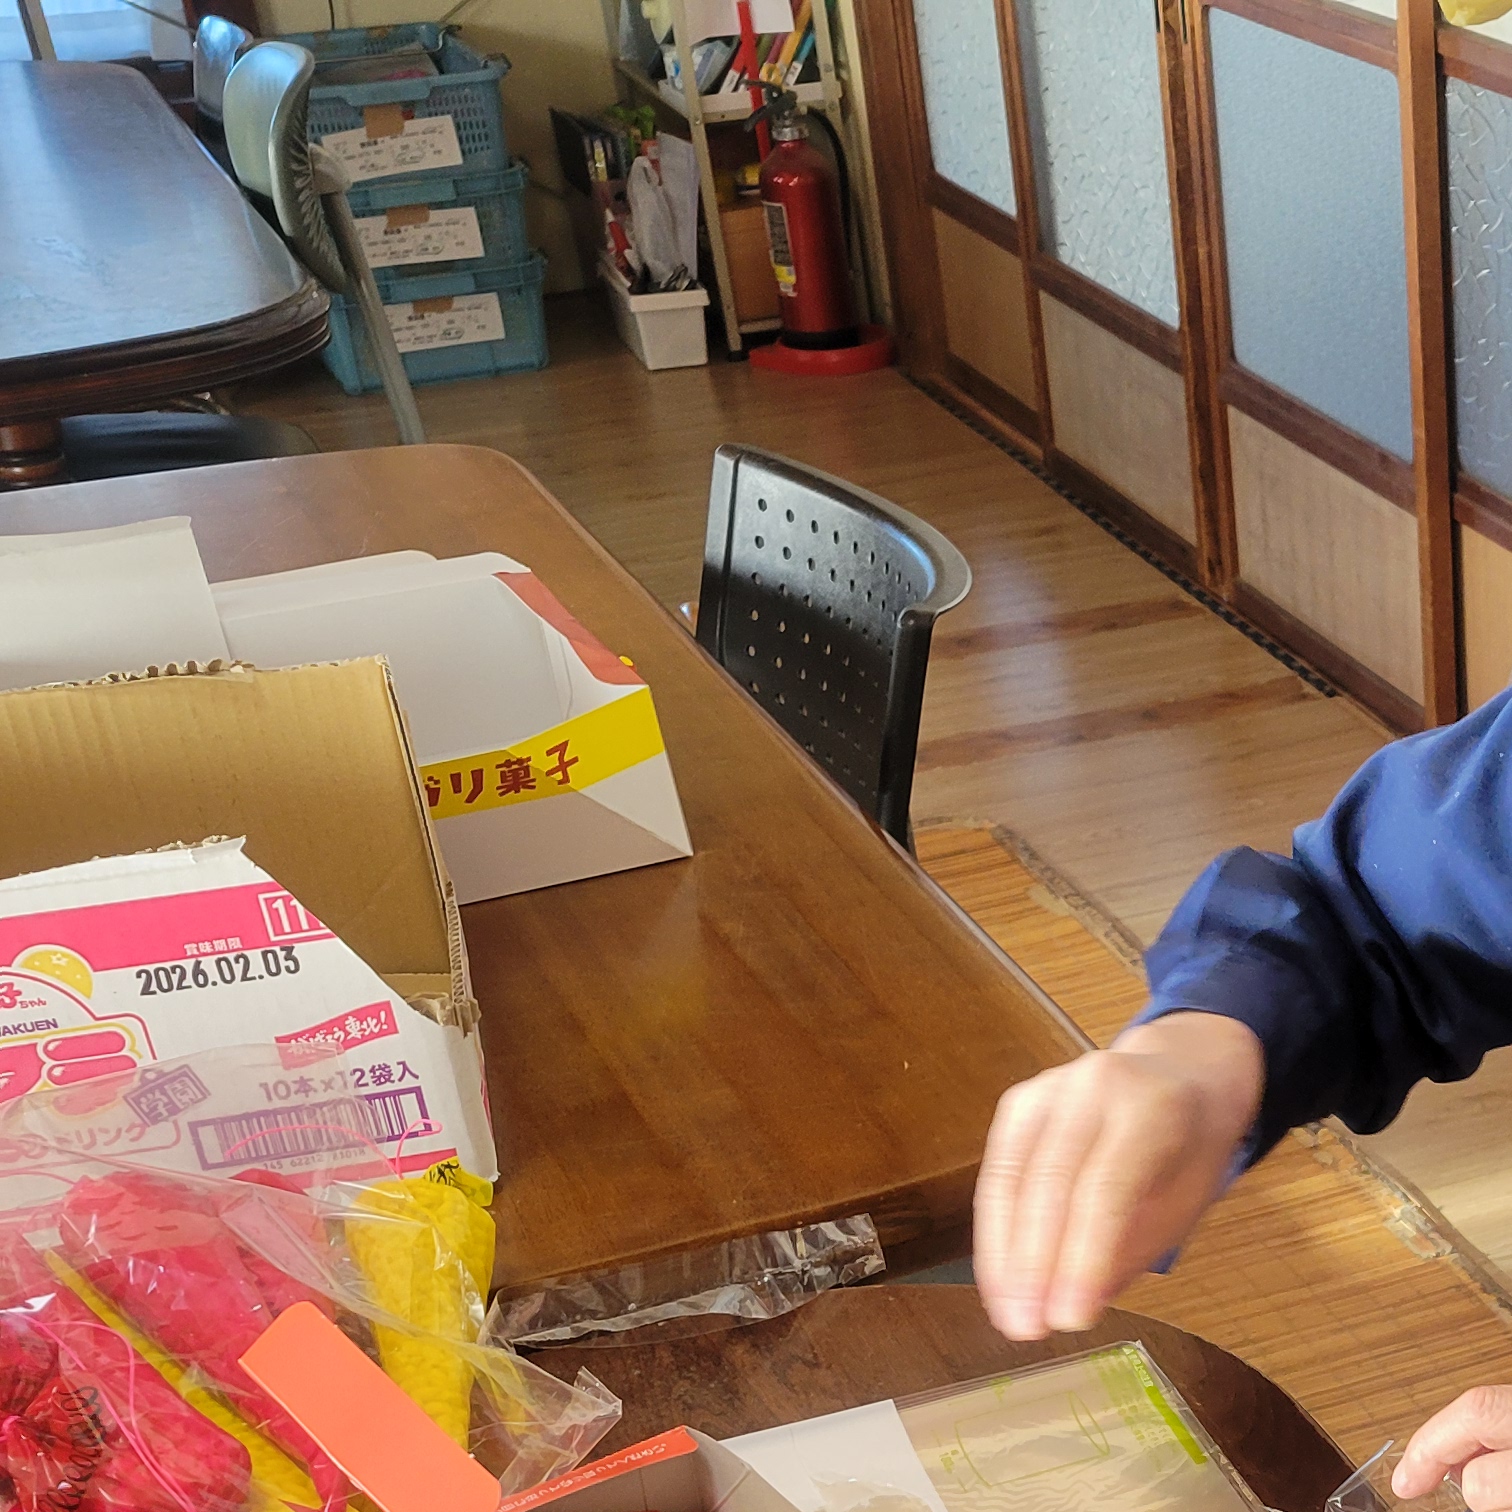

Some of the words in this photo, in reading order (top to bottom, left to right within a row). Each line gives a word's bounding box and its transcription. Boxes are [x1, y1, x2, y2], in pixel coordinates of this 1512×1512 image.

[271, 896, 325, 933] 11
[183, 937, 242, 957] 賞味期限
[135, 946, 301, 996] 2026.02.03
